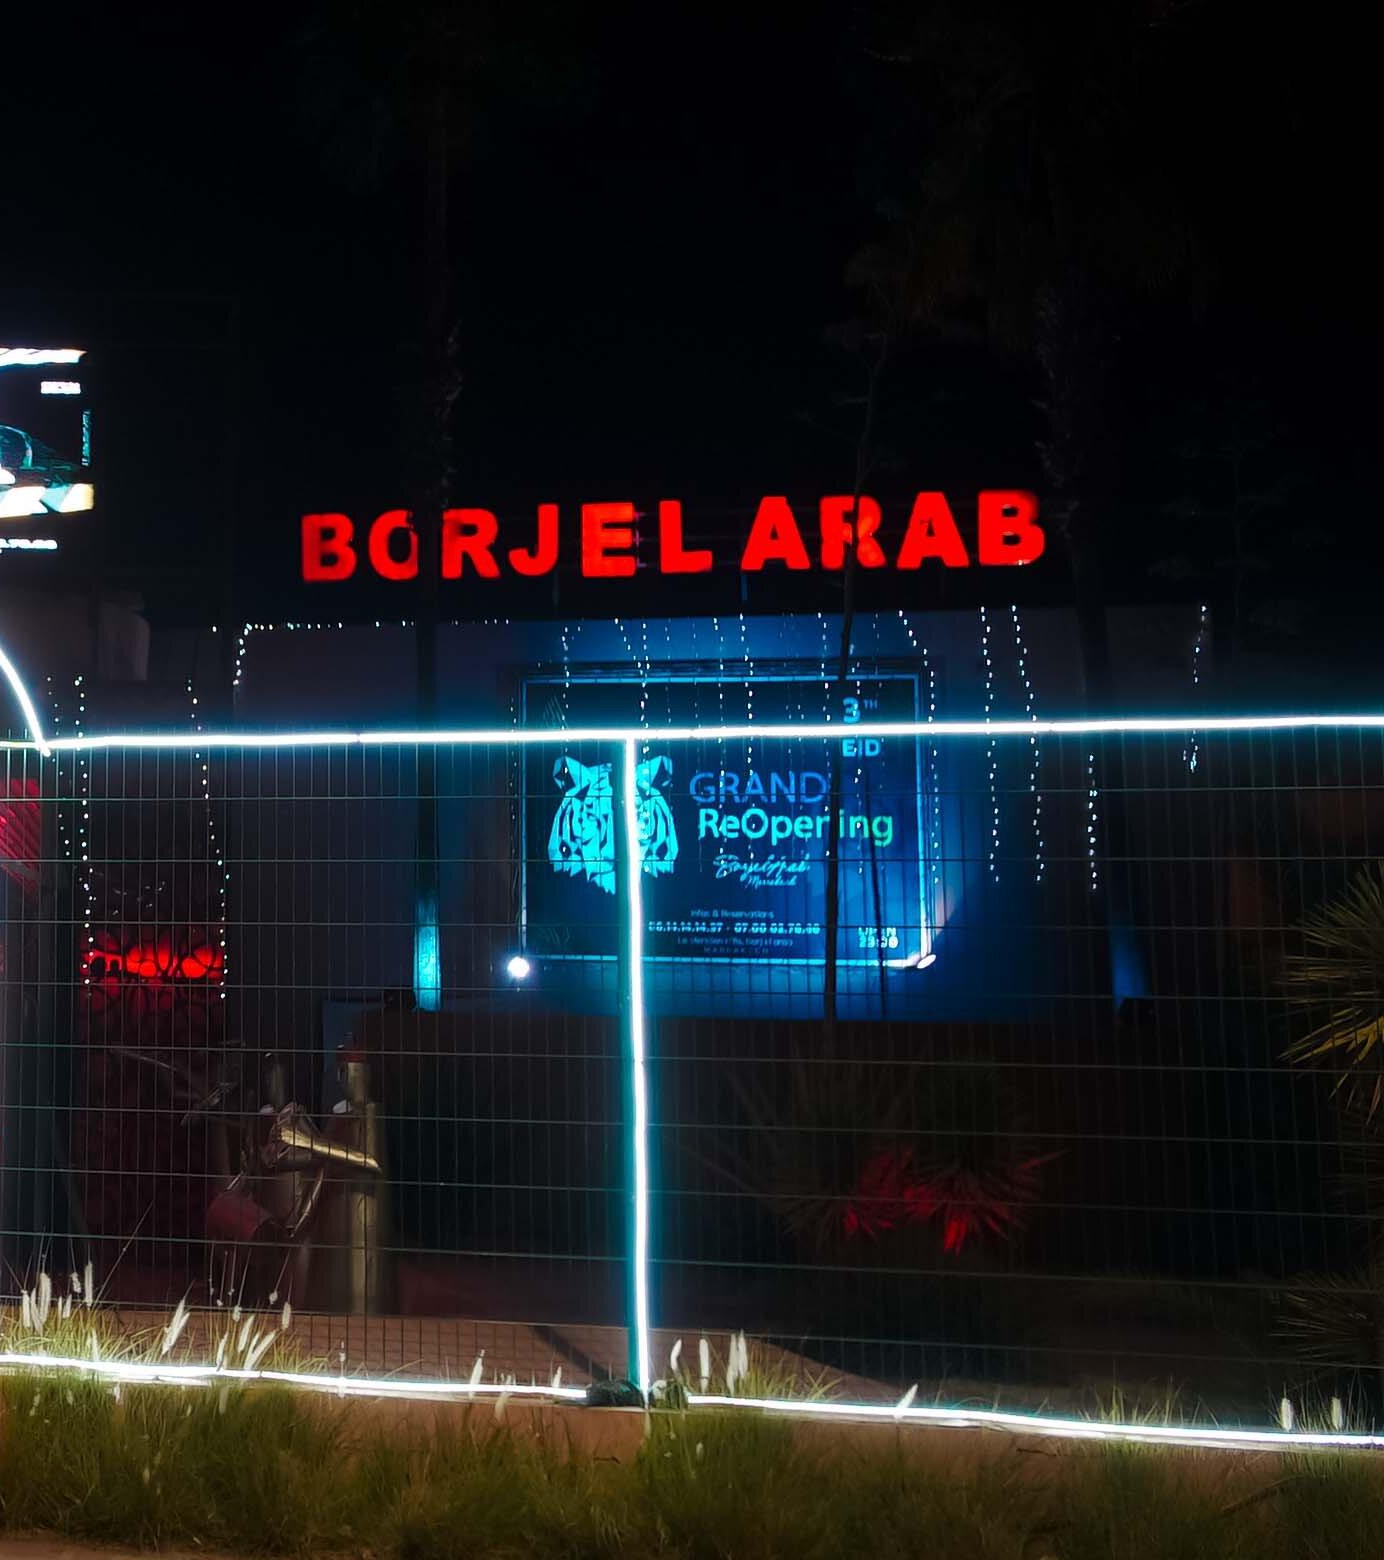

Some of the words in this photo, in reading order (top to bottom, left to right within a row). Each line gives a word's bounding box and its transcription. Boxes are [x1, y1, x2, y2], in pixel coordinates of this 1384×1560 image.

[741, 491, 1045, 571] ARAB
[842, 739, 881, 757] EID
[689, 771, 828, 803] GRAND
